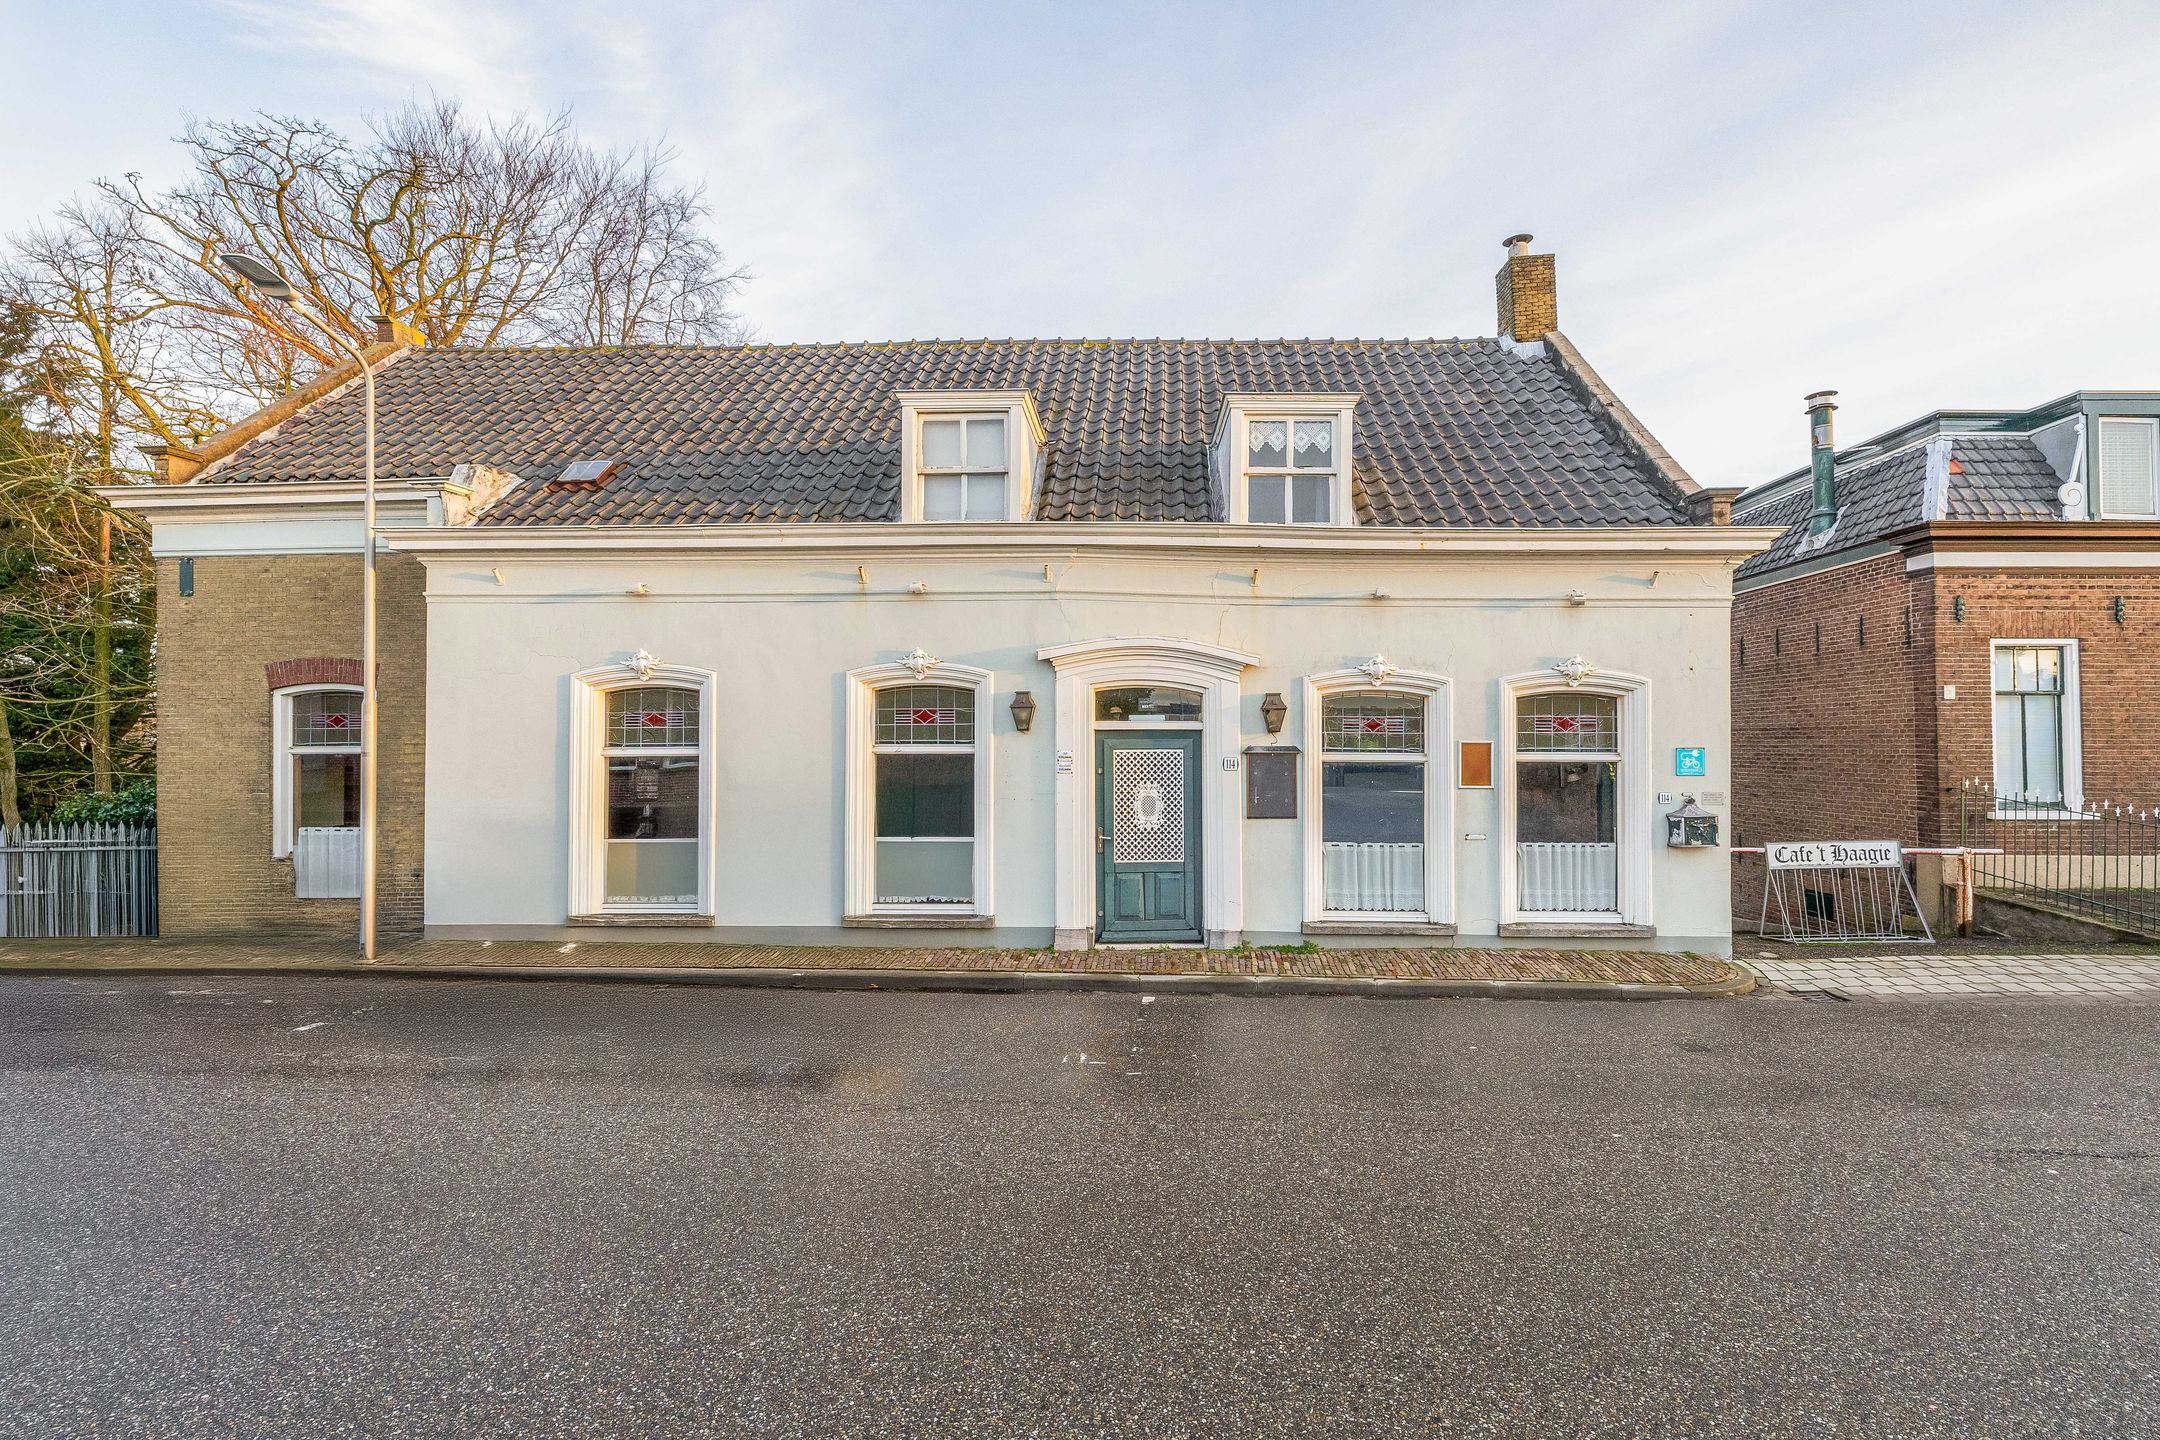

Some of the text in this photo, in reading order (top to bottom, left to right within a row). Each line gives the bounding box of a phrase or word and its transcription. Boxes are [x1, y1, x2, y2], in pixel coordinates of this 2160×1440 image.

[1225, 759, 1236, 769] 114
[1661, 794, 1670, 803] 114
[1774, 846, 1813, 864] Cafe
[1830, 843, 1891, 865] Haagie
